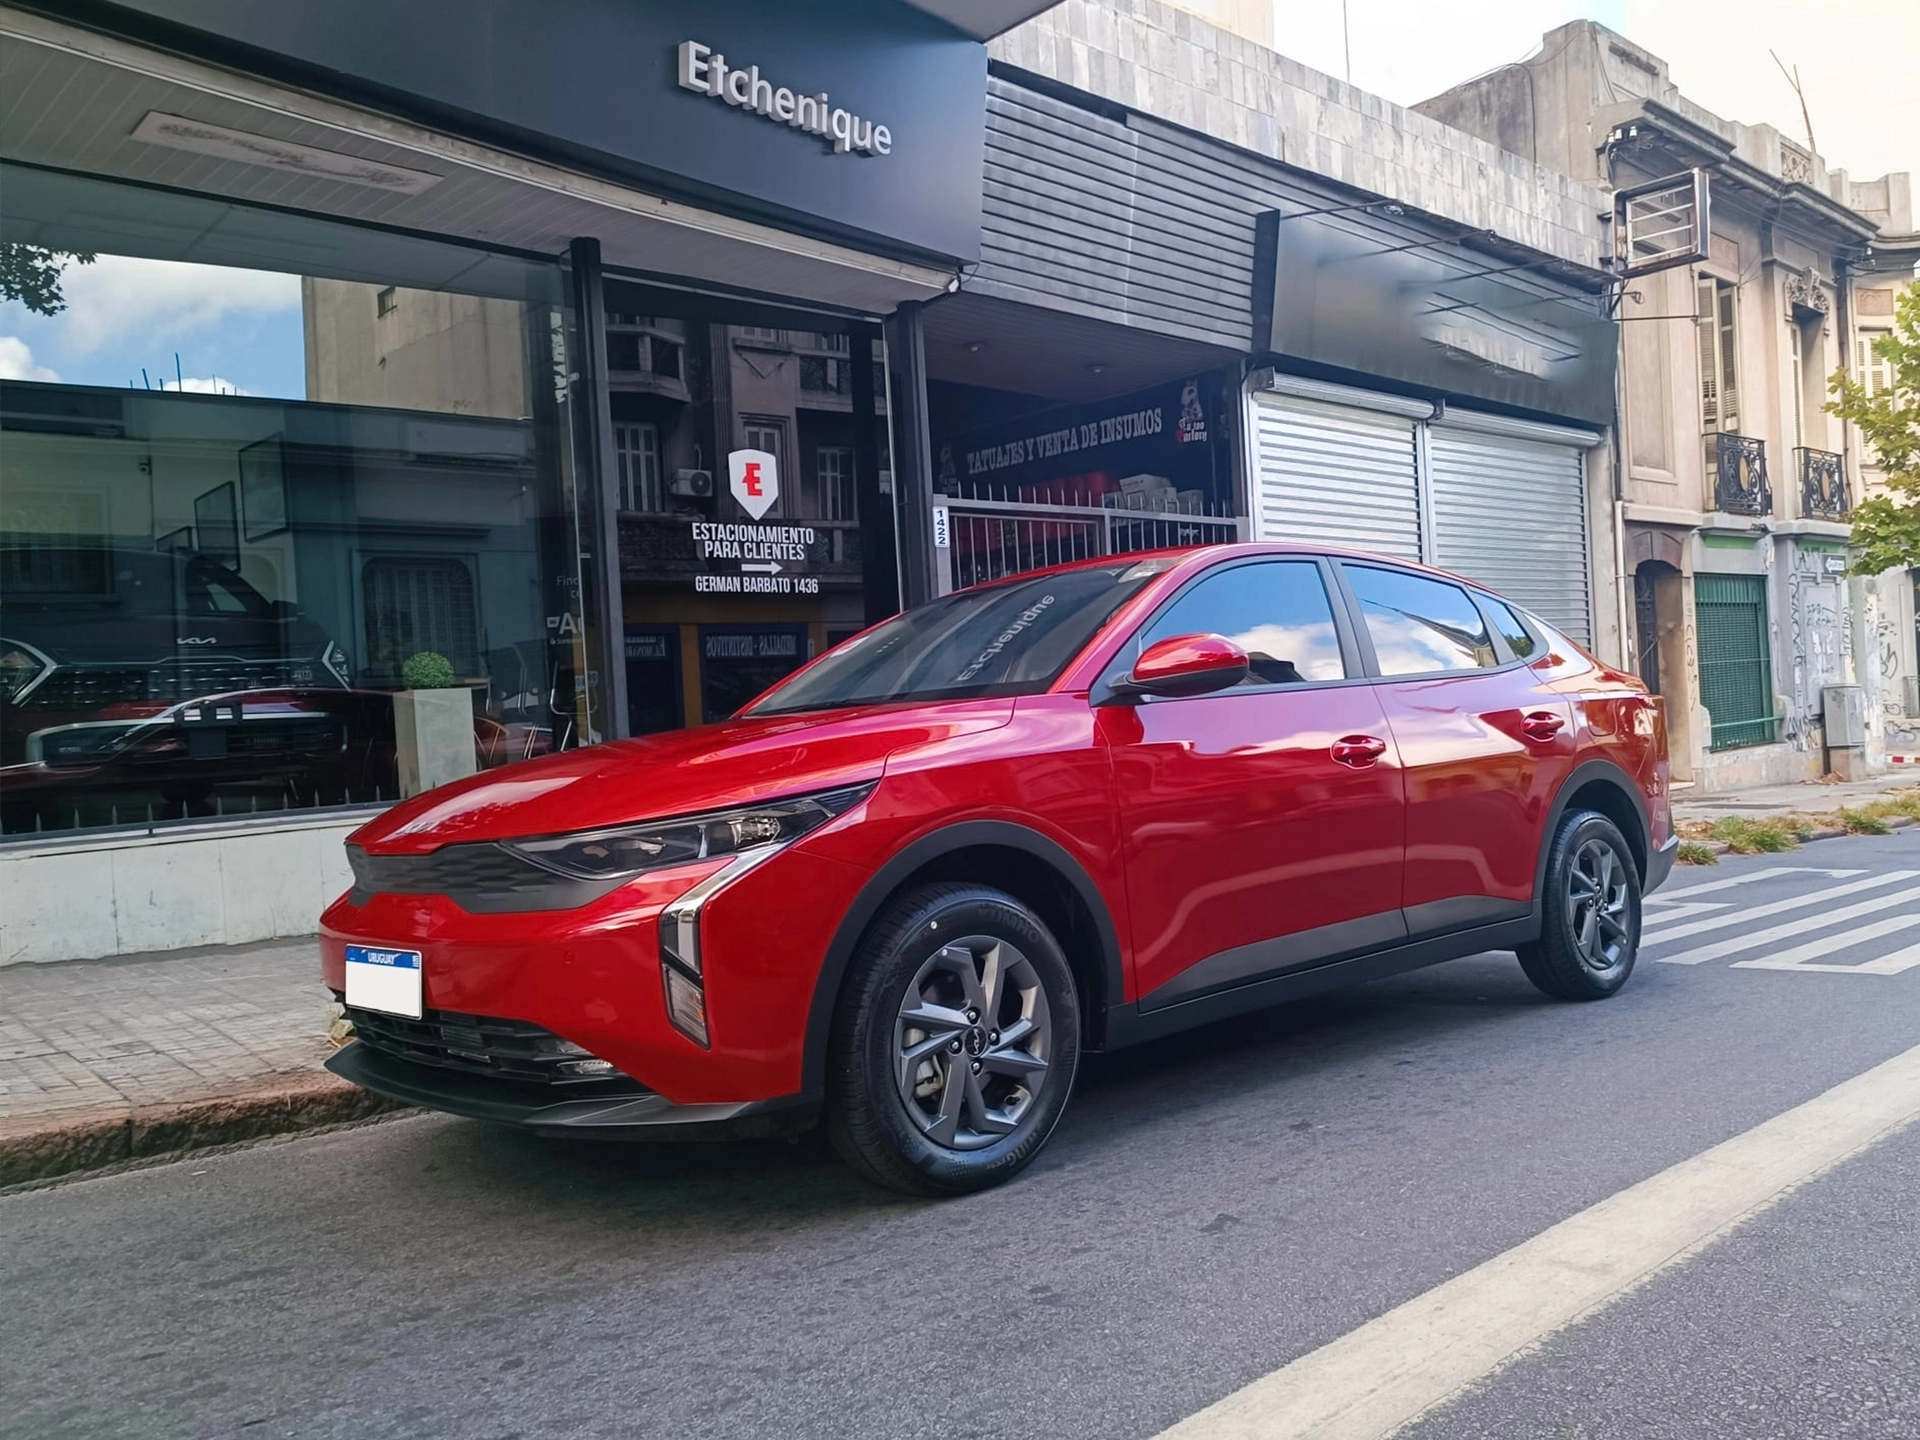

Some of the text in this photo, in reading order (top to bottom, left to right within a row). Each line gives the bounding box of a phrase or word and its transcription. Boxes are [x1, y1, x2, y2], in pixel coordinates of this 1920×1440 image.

[678, 40, 892, 156] Etchenique
[967, 407, 1162, 474] TATUAJES Y VENTA DE INSUMOS
[692, 522, 814, 545] ESTACIONAMIENTO
[936, 510, 946, 545] 1422
[704, 541, 805, 560] PARA CLIENTES
[695, 576, 819, 594] GERMAN BARBATO 1436
[367, 951, 395, 965] URUGUAY
